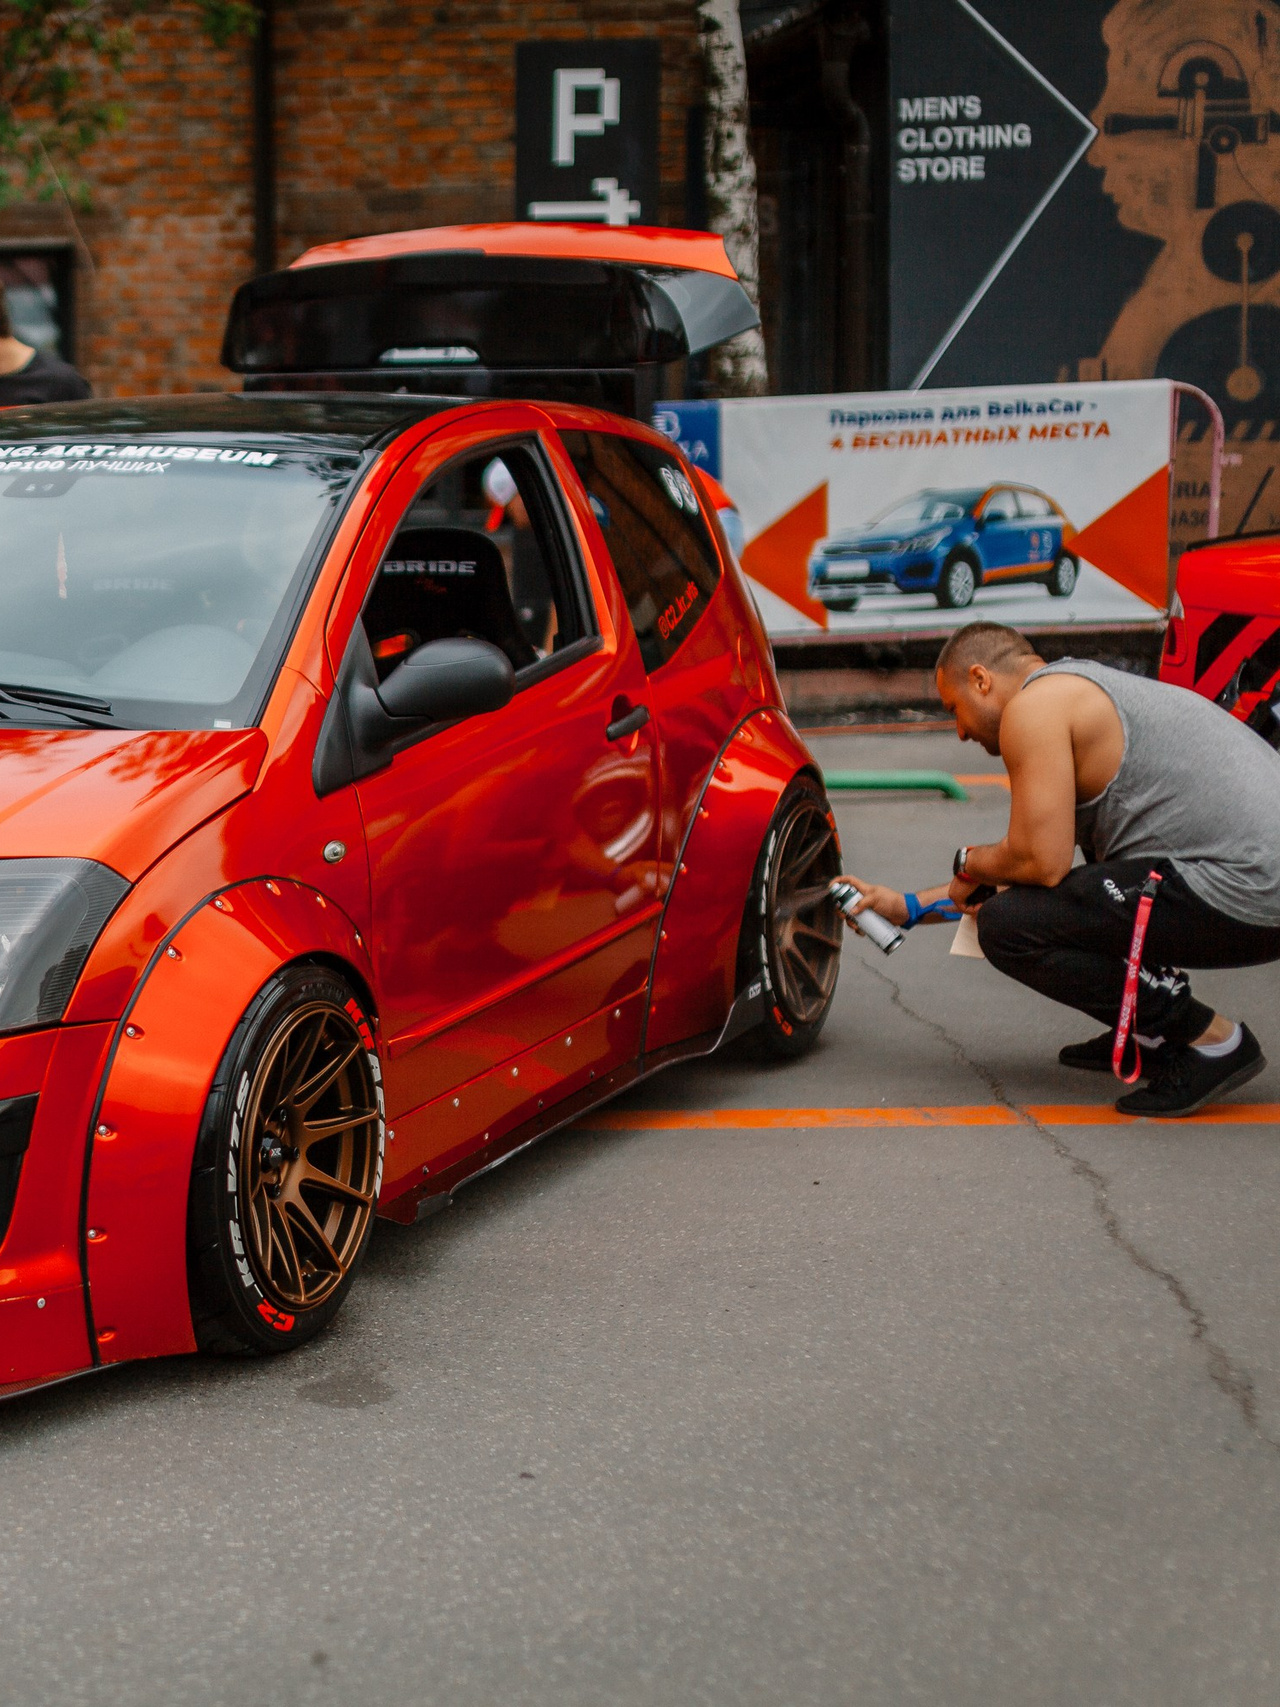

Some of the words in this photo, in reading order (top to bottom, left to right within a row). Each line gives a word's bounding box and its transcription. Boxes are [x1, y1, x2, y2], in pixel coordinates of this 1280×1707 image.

[552, 67, 620, 167] P
[898, 95, 982, 122] MEN'S
[898, 123, 1032, 151] CLOTHING
[898, 155, 986, 183] STORE
[830, 407, 934, 427] Парковка
[940, 404, 981, 423] для
[987, 398, 1084, 417] BelkaCar
[851, 424, 1021, 449] БЕСПЛАТНЫХ
[1027, 420, 1111, 441] МЕСТА
[68, 460, 171, 473] ЛУЧШИХ
[383, 560, 477, 574] BRIDE
